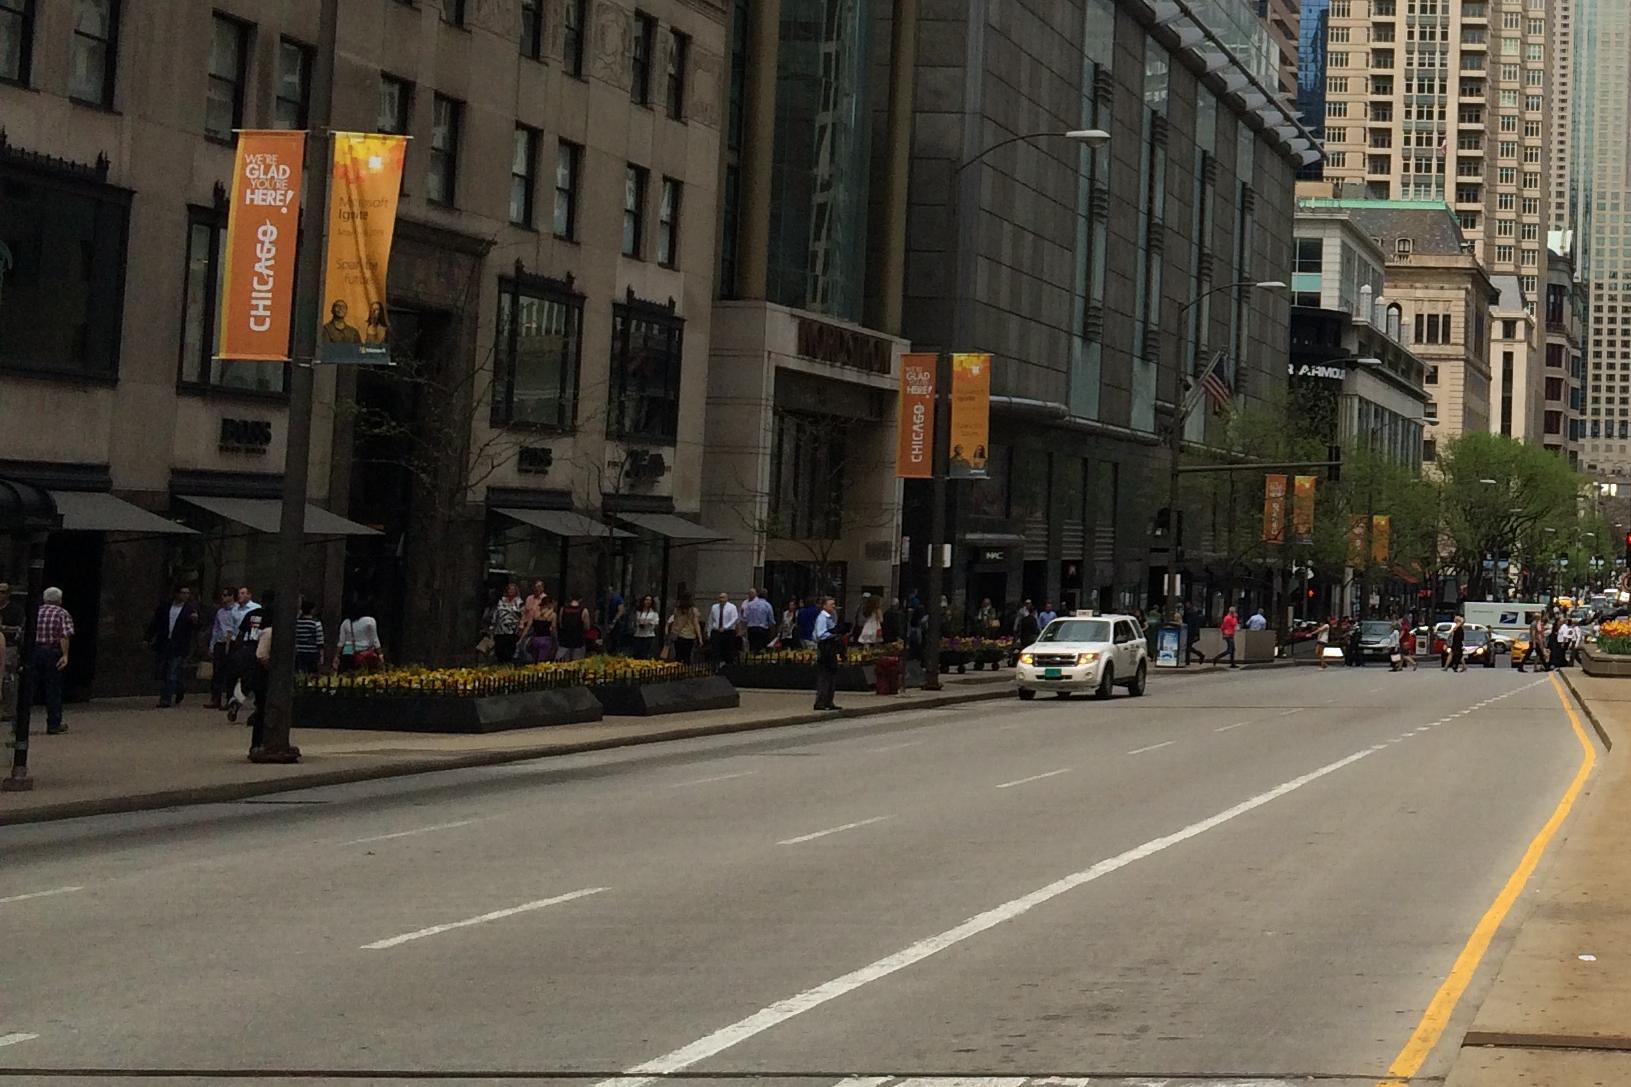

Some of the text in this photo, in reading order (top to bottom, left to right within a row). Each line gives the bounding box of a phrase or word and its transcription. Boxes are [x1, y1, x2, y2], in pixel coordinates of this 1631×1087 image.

[245, 153, 279, 164] WE'RE
[245, 164, 291, 179] GLAD
[250, 179, 288, 190] YOU'RE
[245, 188, 294, 214] HERE!
[248, 219, 278, 332] CHICAGO
[911, 402, 926, 463] CHICAGO
